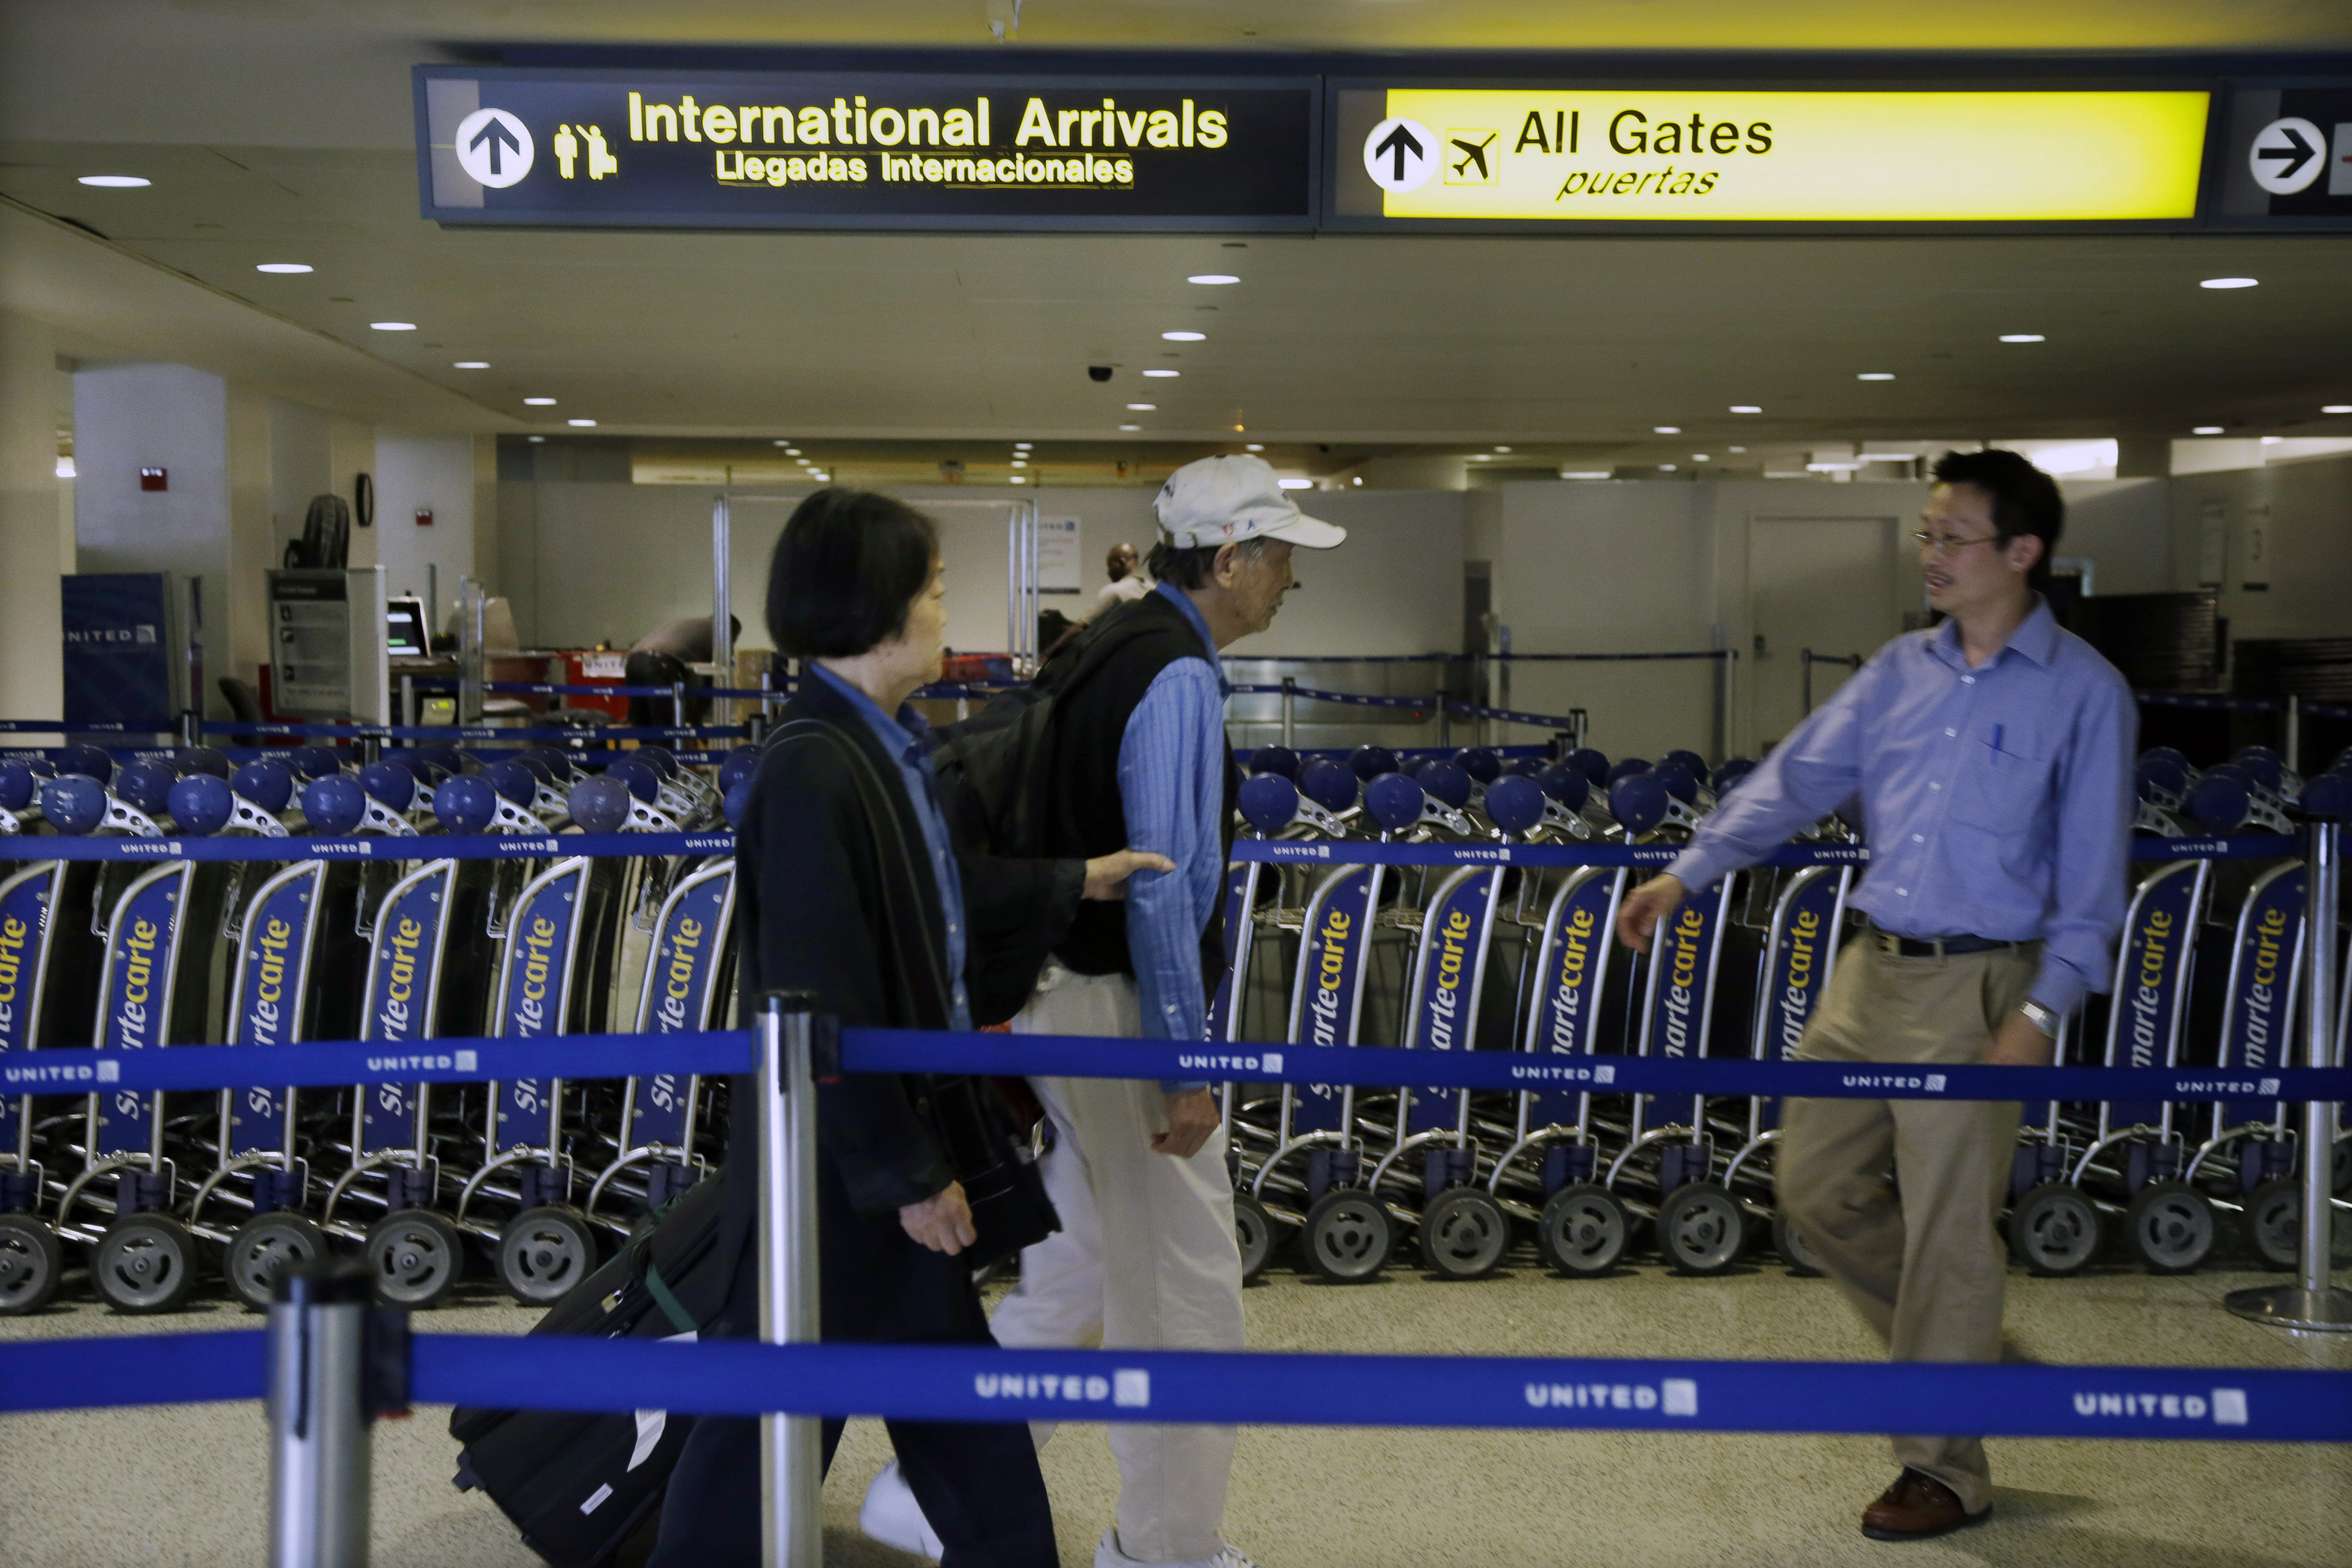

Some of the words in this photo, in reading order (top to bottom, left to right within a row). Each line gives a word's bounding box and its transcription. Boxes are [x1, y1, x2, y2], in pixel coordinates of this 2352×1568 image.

[628, 91, 990, 146] International
[1015, 99, 1228, 147] Arrivals
[1515, 111, 1579, 154] All
[1609, 109, 1773, 155] Gates
[716, 151, 867, 186] Llegadas
[882, 152, 1133, 182] Internacionales
[1555, 166, 1719, 201] puertas
[68, 629, 132, 642] NITED
[121, 844, 168, 853] UNITED
[311, 844, 358, 853] UNITED
[500, 842, 545, 851] UNITED
[685, 839, 730, 848] UNITED
[2171, 843, 2215, 852] UNITED
[1273, 847, 1317, 856] UNITED
[1454, 850, 1498, 859] UNITED
[1814, 850, 1857, 858] UNITED
[1552, 909, 1594, 1055] artecarte
[2244, 908, 2286, 1068] martecarte
[367, 1055, 451, 1072] UNITED
[1179, 1055, 1259, 1070] UNITED
[5, 1065, 93, 1082] UNITED
[1512, 1066, 1591, 1080] UNITED
[1843, 1076, 1922, 1088] UNITED
[2176, 1082, 2255, 1093] UNITED
[975, 1374, 1110, 1401] UNITED
[1524, 1384, 1658, 1409] UNITED
[2073, 1393, 2207, 1418] UNITED
